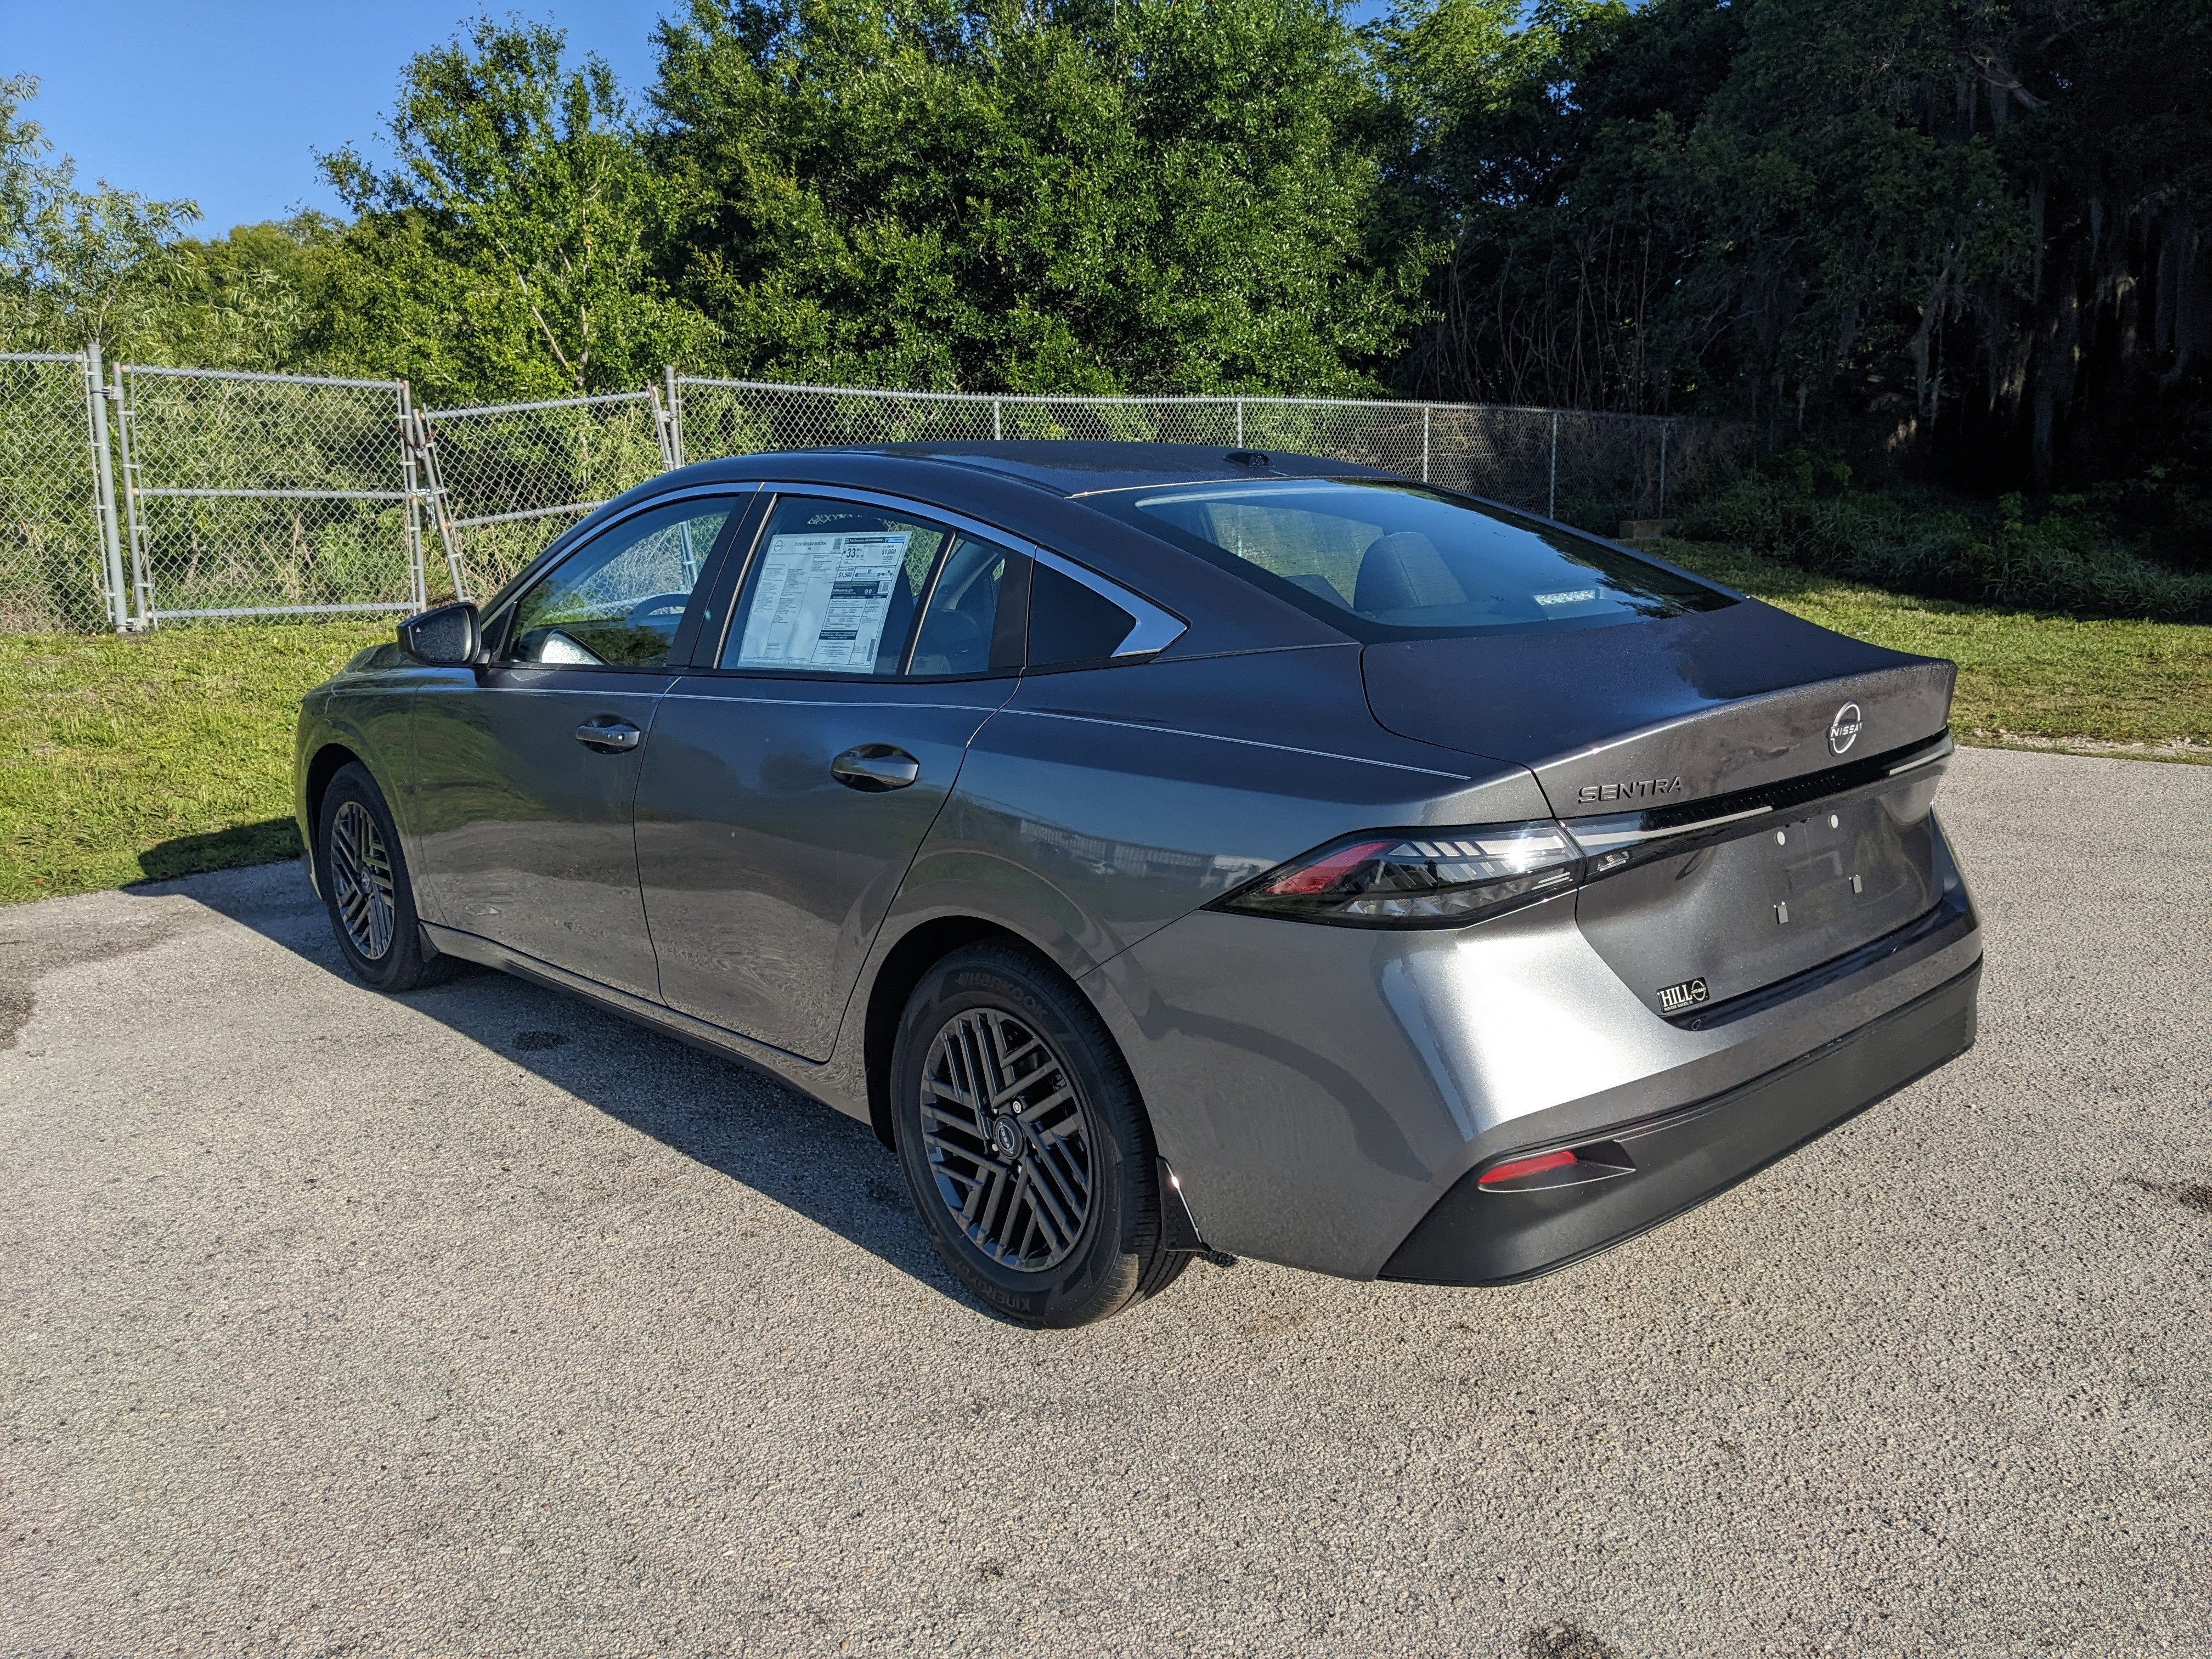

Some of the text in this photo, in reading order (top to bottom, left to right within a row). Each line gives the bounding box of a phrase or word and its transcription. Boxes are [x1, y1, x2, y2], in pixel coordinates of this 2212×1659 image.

[846, 548, 856, 558] 33
[1830, 722, 1864, 737] NISSAN
[1578, 775, 1683, 804] SENTRA
[1660, 984, 1692, 1007] HILL
